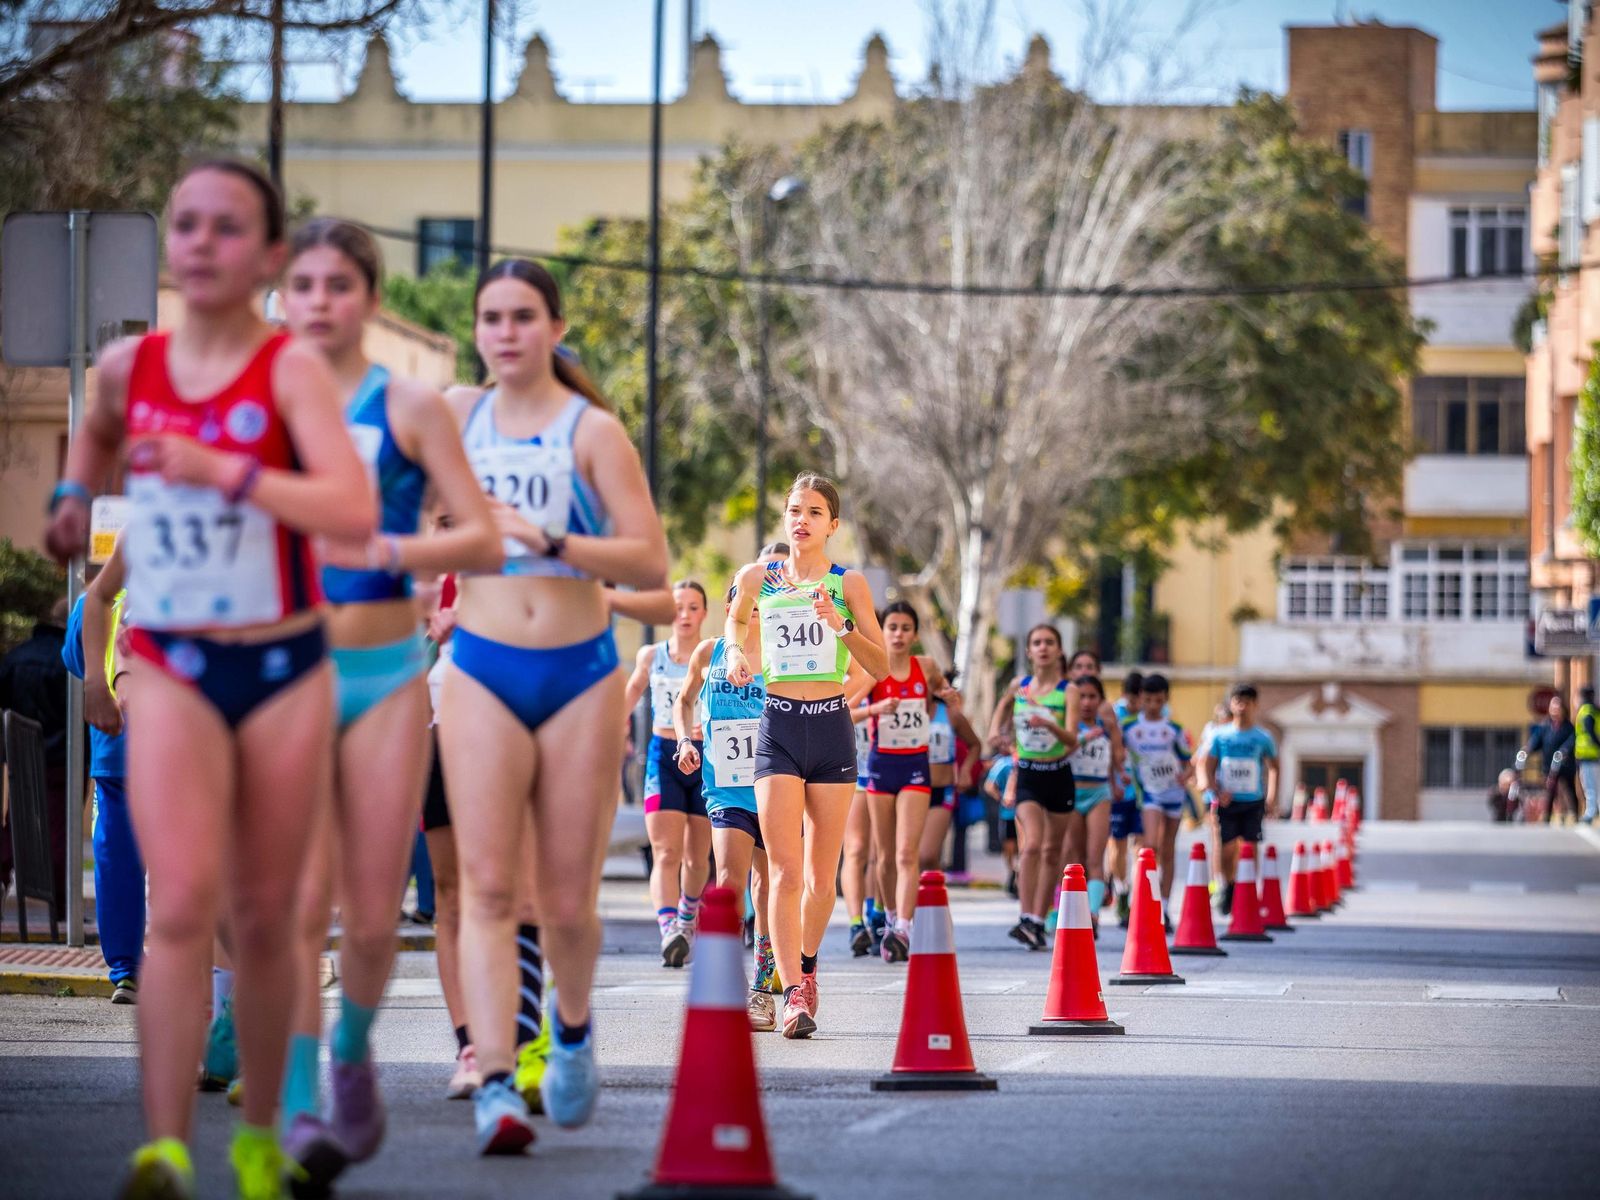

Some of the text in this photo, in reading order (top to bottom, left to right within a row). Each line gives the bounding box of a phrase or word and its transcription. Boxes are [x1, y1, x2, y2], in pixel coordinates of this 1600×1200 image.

[482, 474, 548, 511] 320
[148, 512, 242, 569] 337
[776, 621, 824, 649] 340
[716, 699, 756, 709] ATLETISMO
[764, 696, 793, 712] PRO
[799, 699, 840, 715] NIKE
[888, 711, 923, 729] 328
[726, 735, 755, 760] 31
